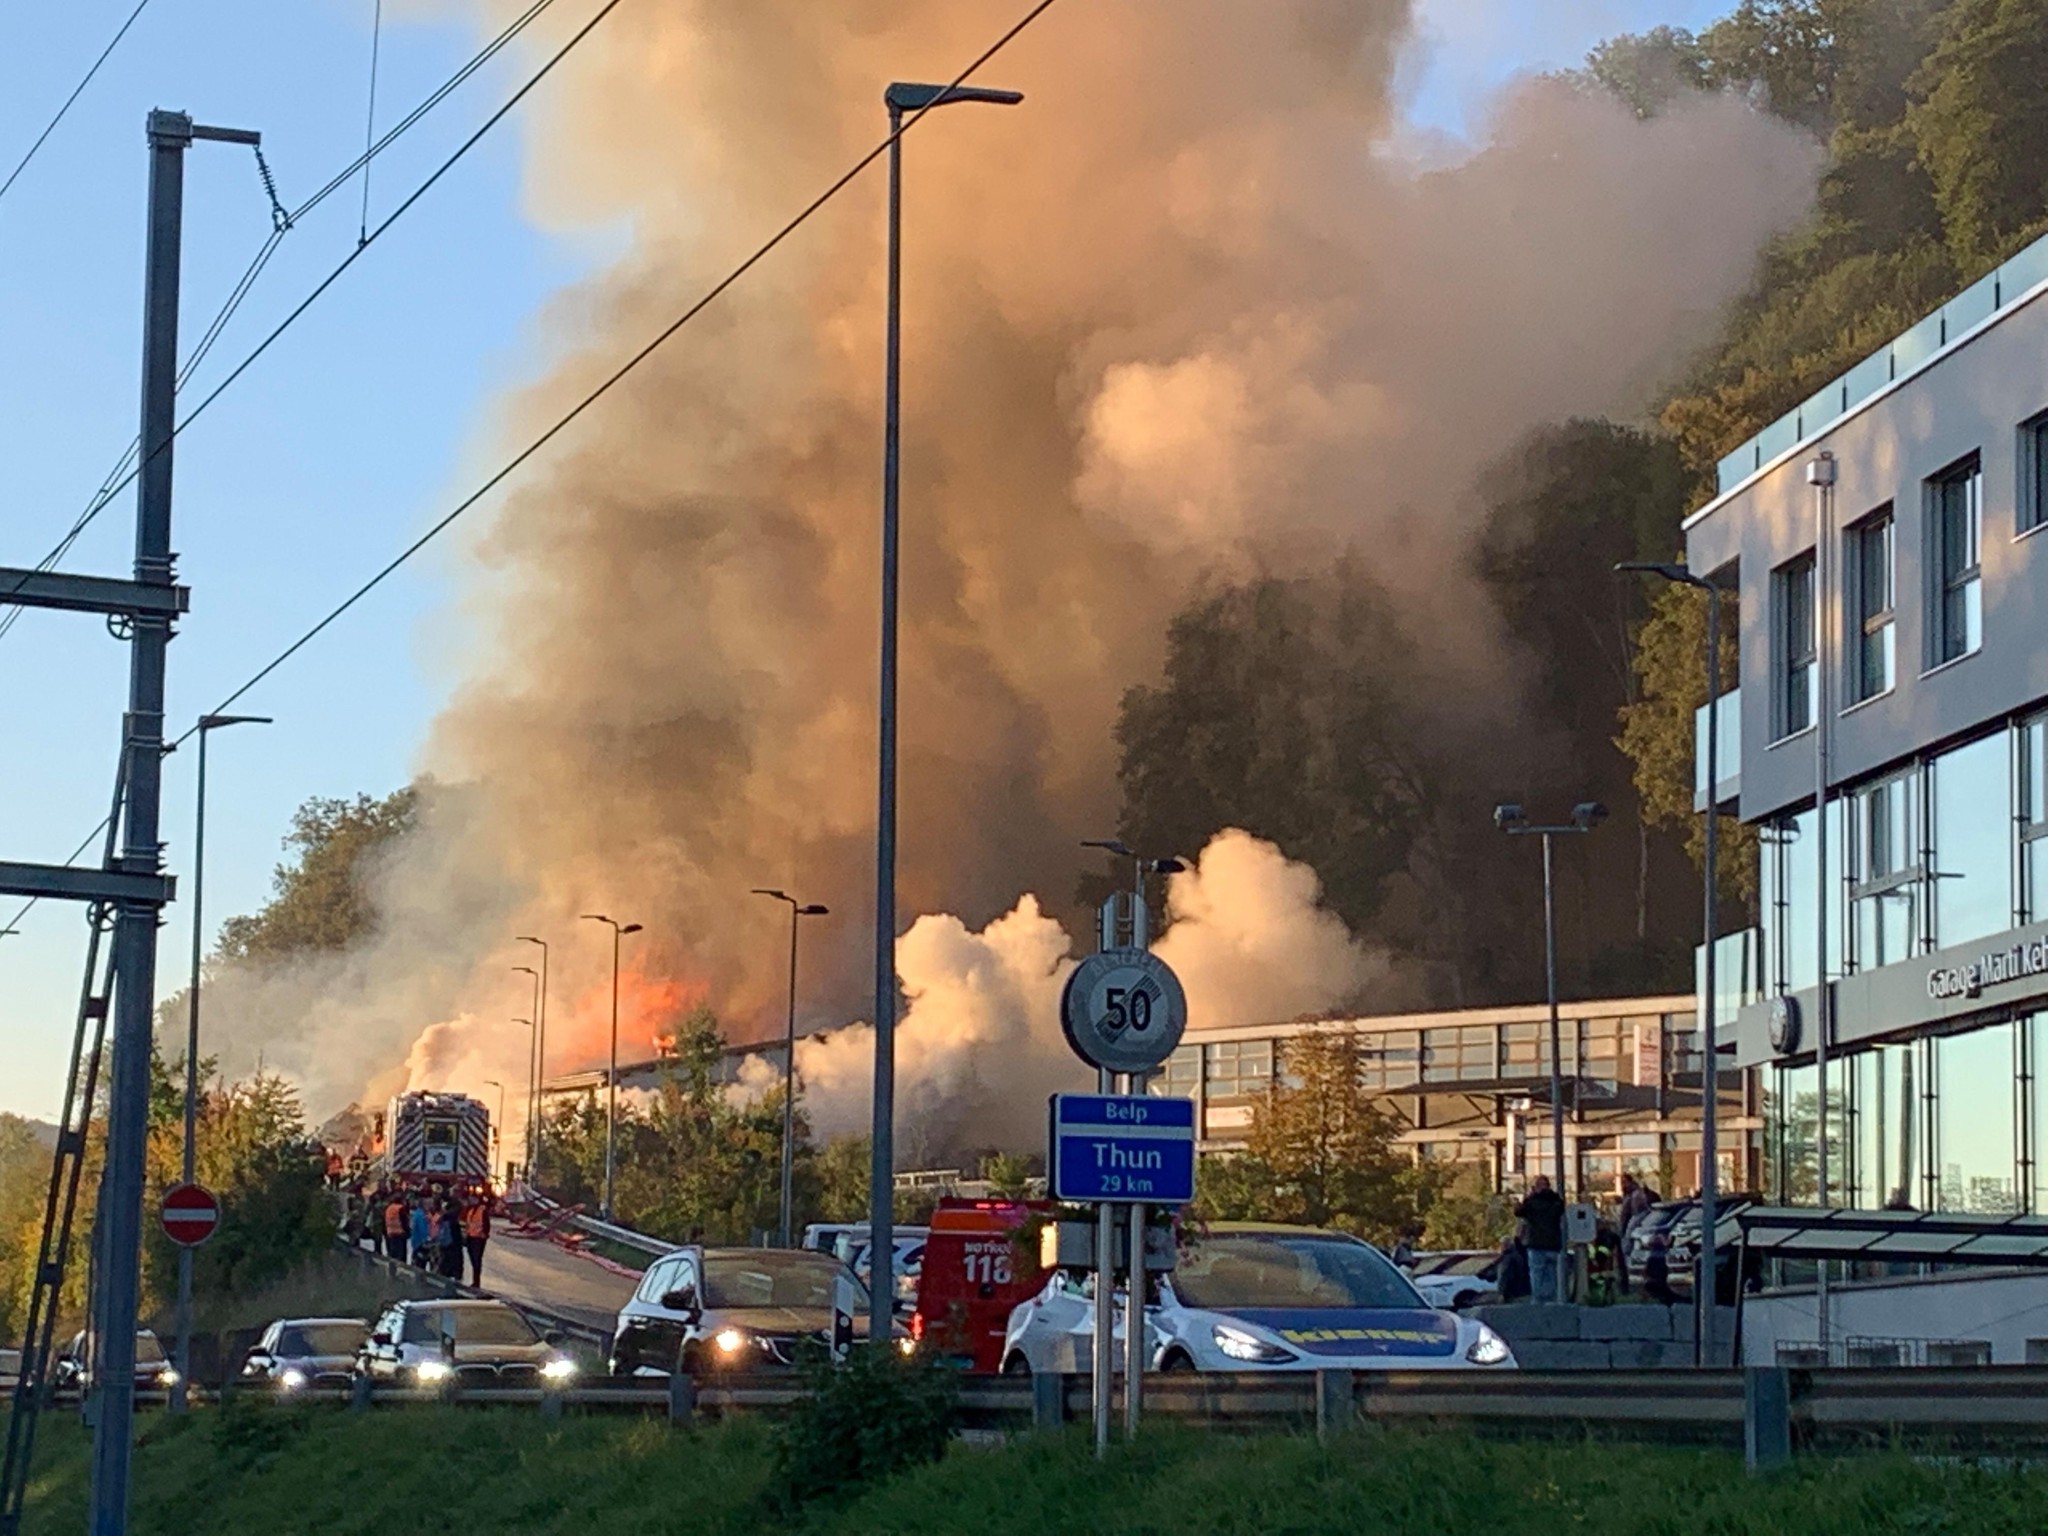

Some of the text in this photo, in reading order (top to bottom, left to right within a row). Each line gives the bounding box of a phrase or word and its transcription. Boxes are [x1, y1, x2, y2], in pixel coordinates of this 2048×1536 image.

[1927, 964, 1977, 999] Garage
[1980, 944, 2019, 984] Marti
[1106, 988, 1151, 1032] 50
[1106, 1102, 1148, 1123] Belp
[1092, 1143, 1162, 1169] Thun
[1101, 1175, 1153, 1193] 29 km
[963, 1254, 1012, 1284] 118
